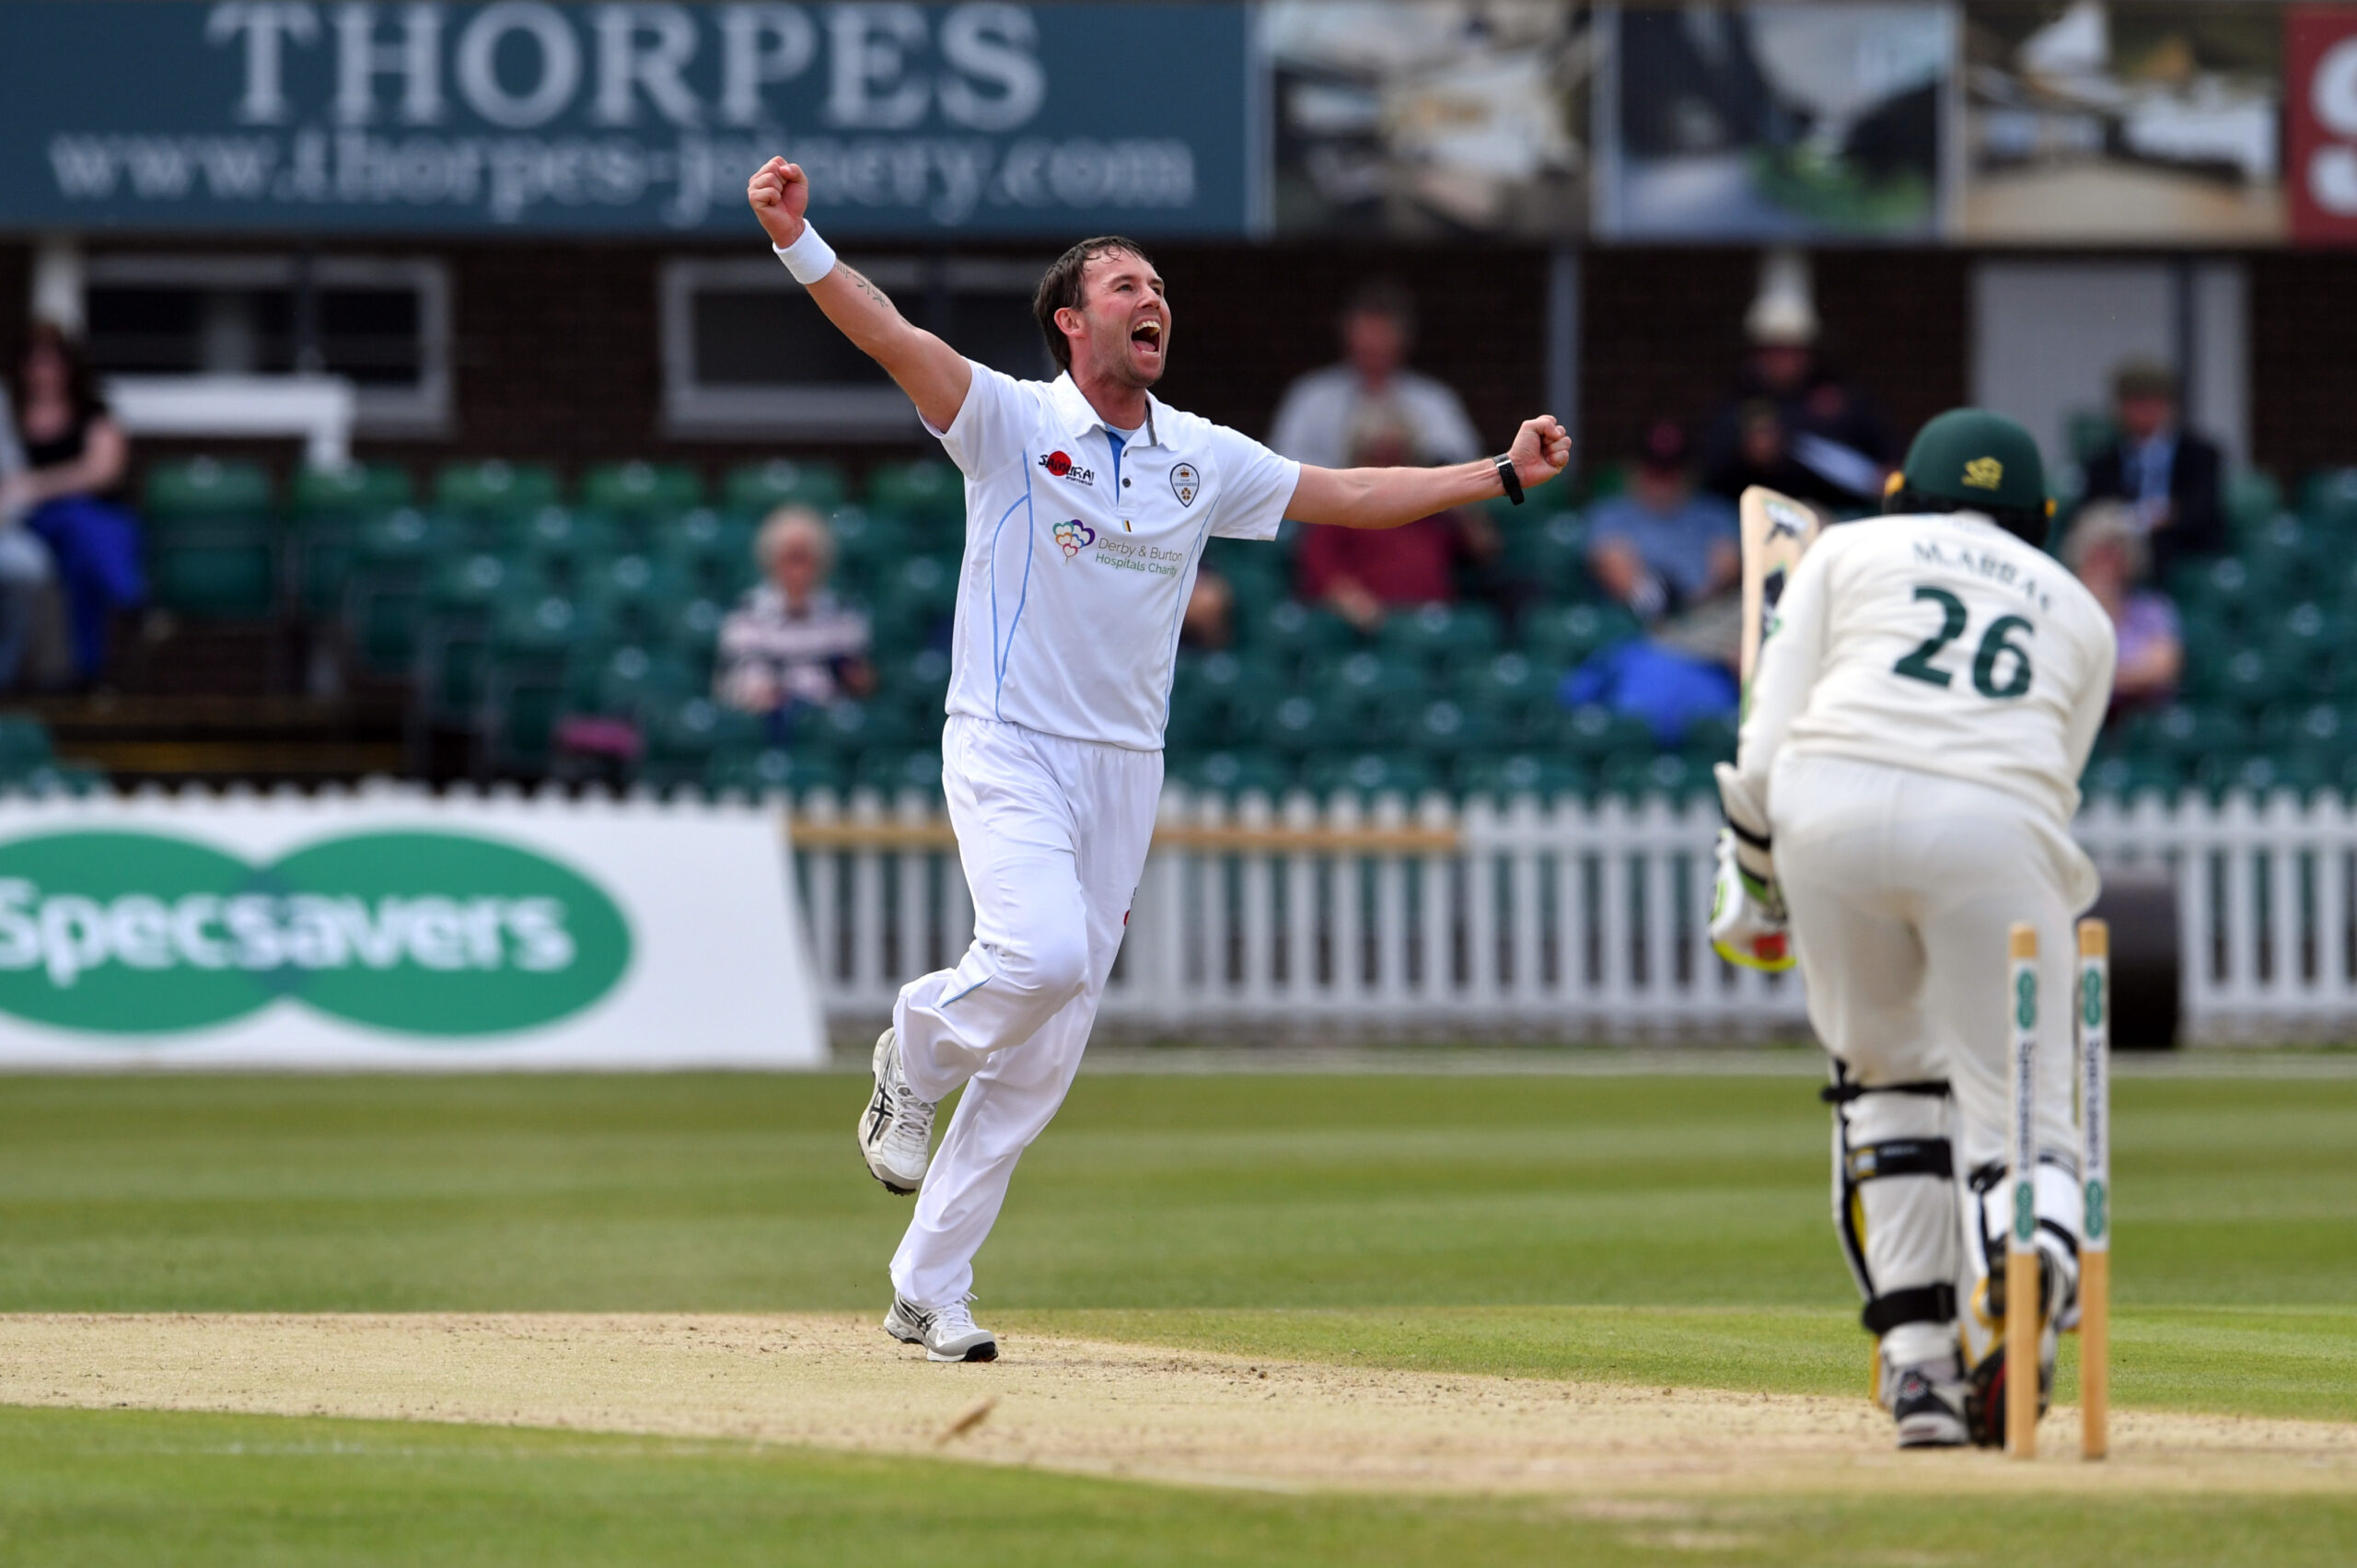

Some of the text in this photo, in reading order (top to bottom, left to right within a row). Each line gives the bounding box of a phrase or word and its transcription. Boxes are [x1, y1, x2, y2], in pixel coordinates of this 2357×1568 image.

[204, 0, 1048, 129] THORPES
[1039, 454, 1095, 482] SAMURAI
[1096, 552, 1178, 578] Hospitals Charity
[1098, 537, 1183, 562] Derby & Burton
[1892, 586, 2034, 701] 26
[0, 877, 575, 988] Specsavers
